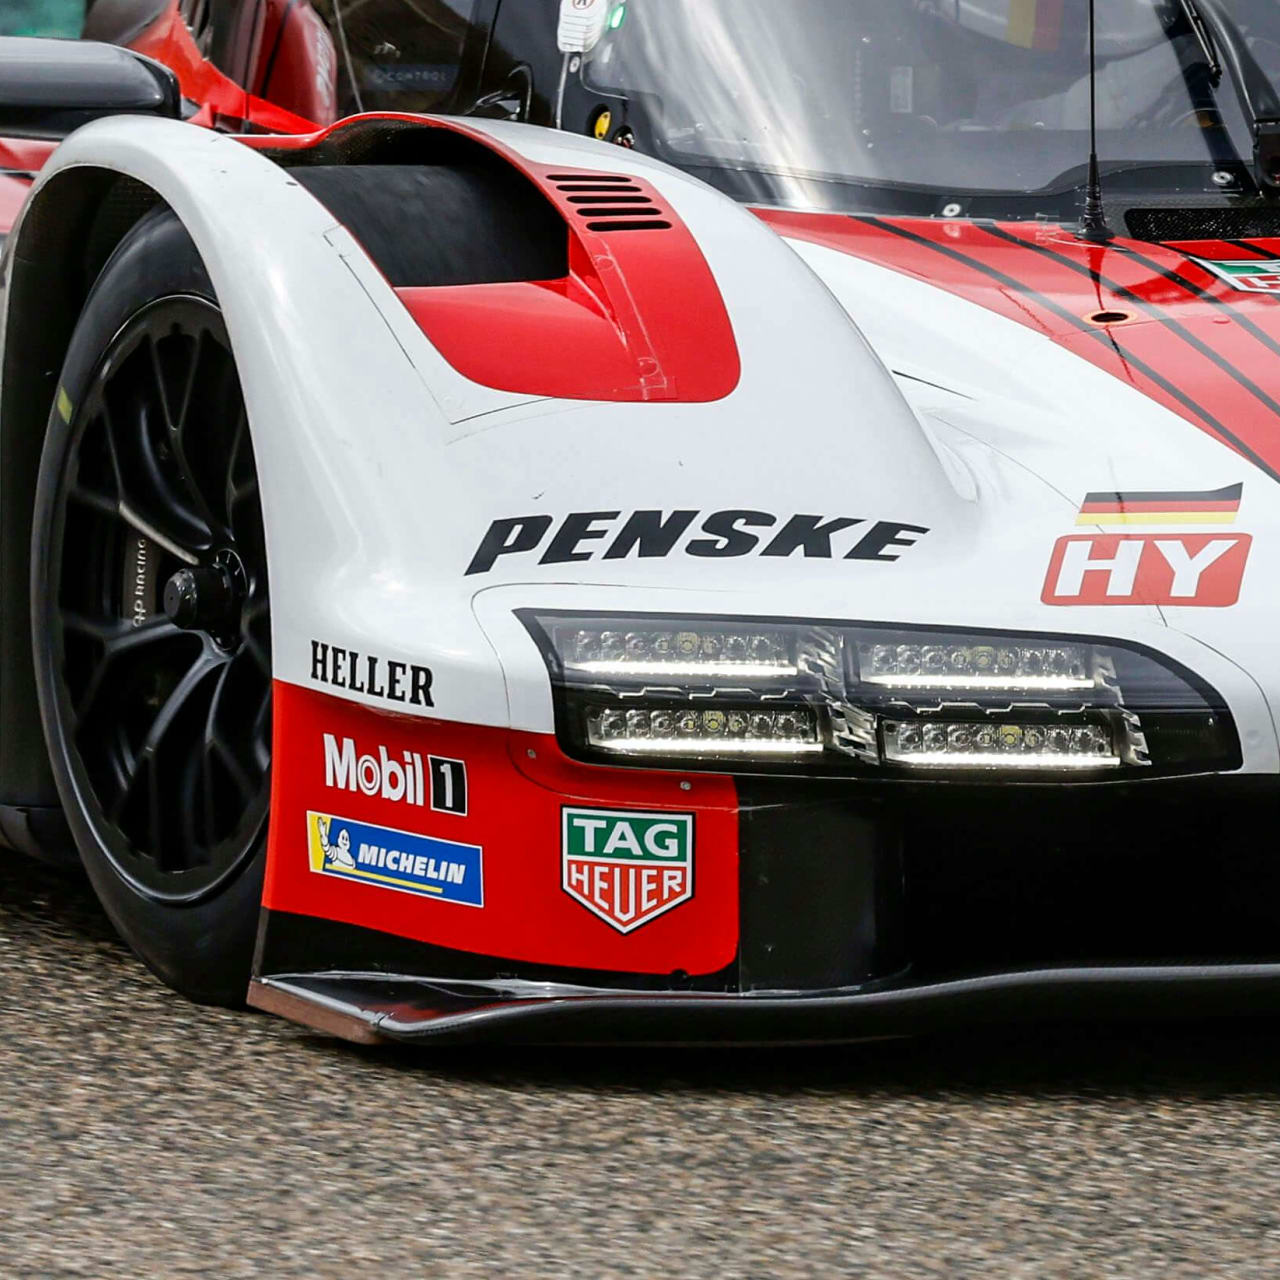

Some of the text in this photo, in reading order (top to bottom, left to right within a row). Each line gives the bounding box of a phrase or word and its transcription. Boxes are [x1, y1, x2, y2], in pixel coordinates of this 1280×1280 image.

[464, 509, 930, 577] PENSKE
[1056, 533, 1240, 598] HY
[311, 639, 435, 708] HELLER
[323, 732, 425, 807] Mobil
[357, 842, 467, 885] MICHELIN
[572, 817, 680, 858] TAG
[569, 863, 684, 922] HEUER
